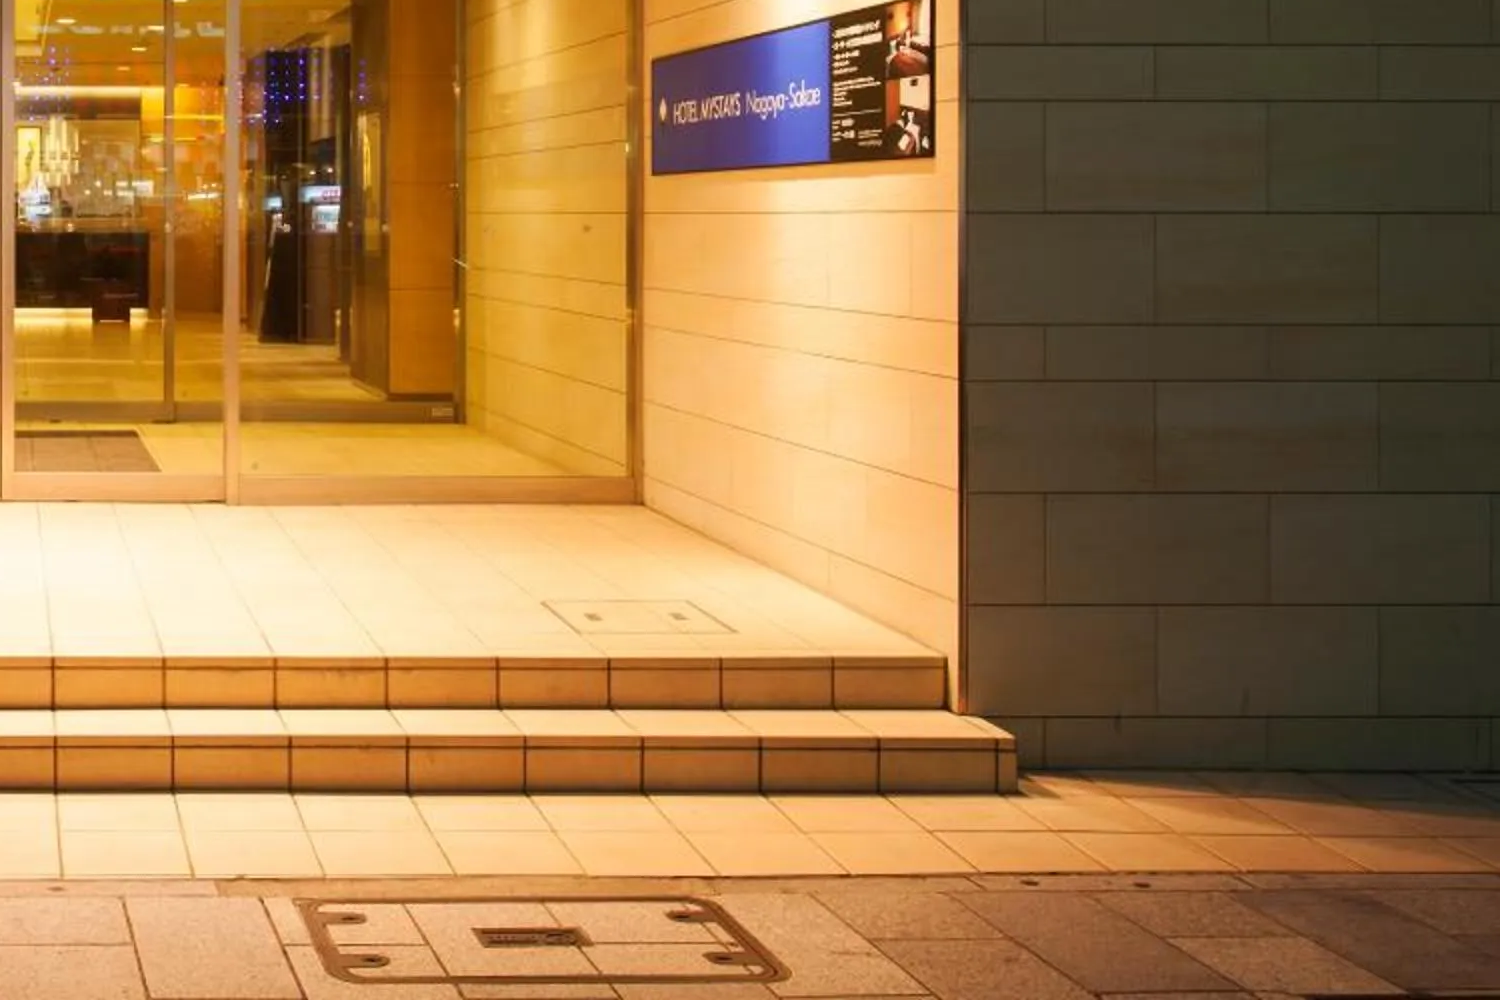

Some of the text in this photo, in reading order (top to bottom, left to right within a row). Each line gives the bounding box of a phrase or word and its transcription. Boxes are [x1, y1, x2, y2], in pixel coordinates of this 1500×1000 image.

[673, 99, 699, 125] HOTEL
[700, 92, 741, 120] MYSTAYS
[745, 79, 821, 121] Nagoya-Sakae
